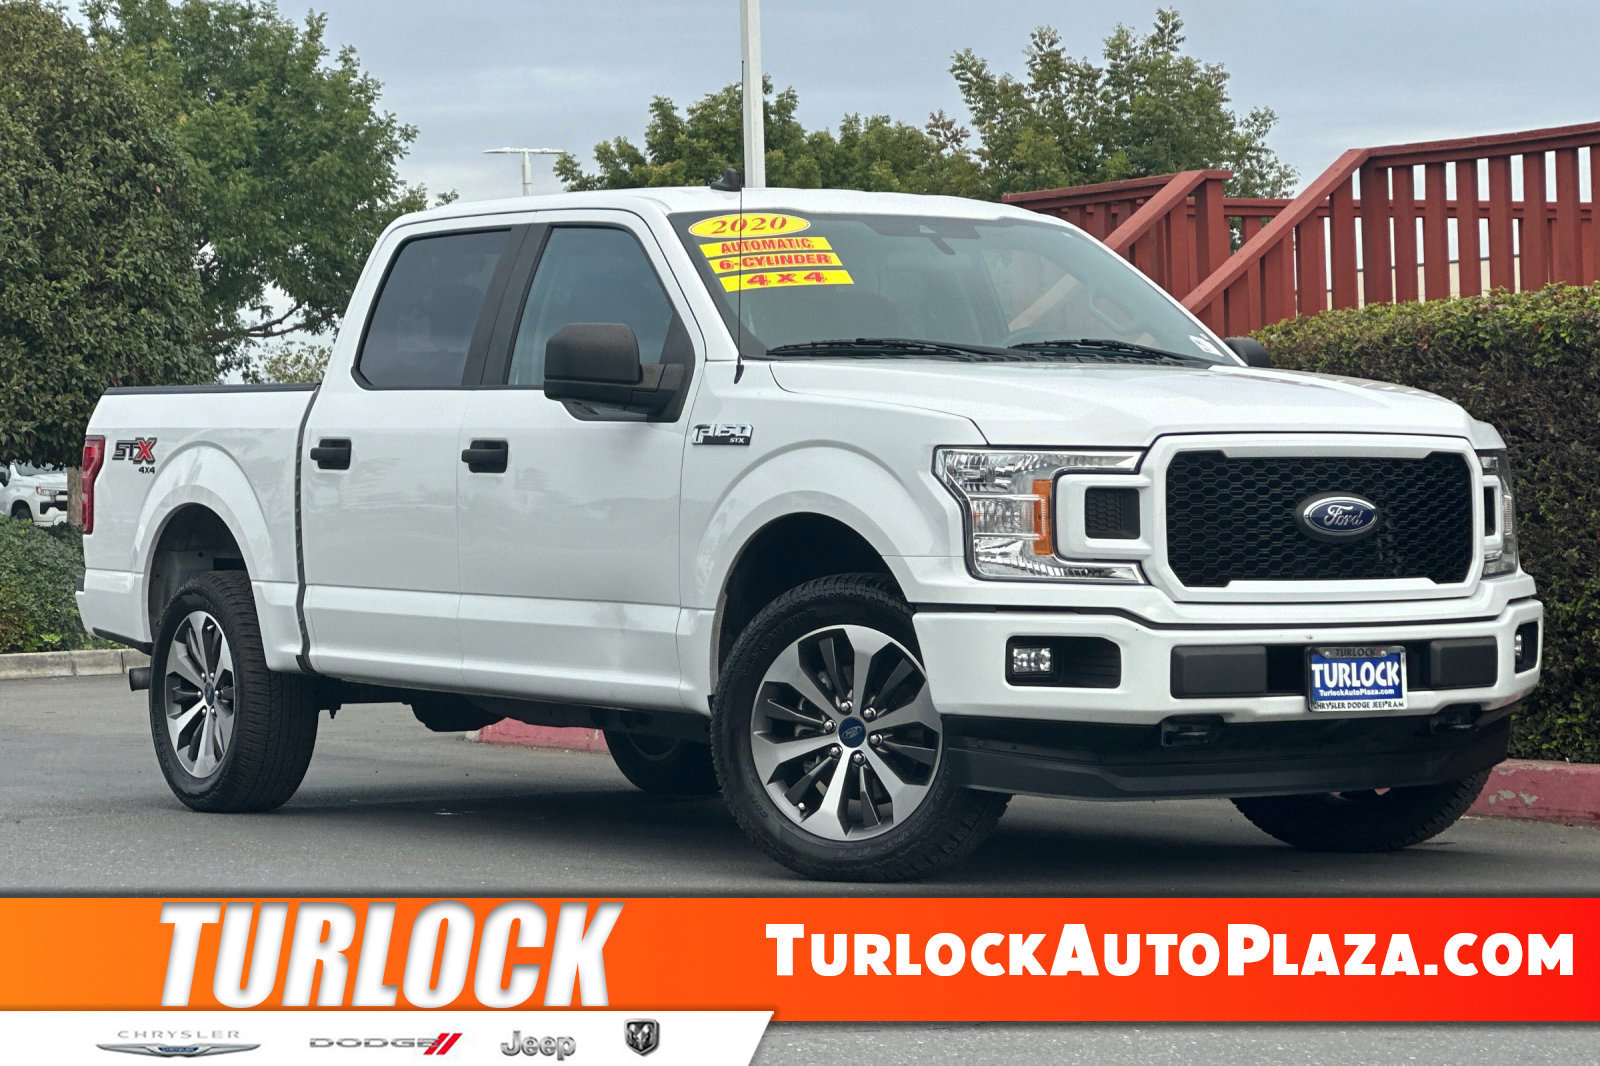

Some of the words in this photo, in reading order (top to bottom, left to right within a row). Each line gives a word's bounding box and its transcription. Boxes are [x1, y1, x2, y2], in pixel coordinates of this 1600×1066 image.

[710, 216, 787, 234] 2020
[721, 238, 814, 254] AUTOMATIC
[719, 253, 832, 270] 6-CYLINDER
[112, 437, 157, 464] STX
[1324, 505, 1363, 526] Ford
[1336, 648, 1376, 656] TURLOCK
[1311, 661, 1399, 688] TURLOCK
